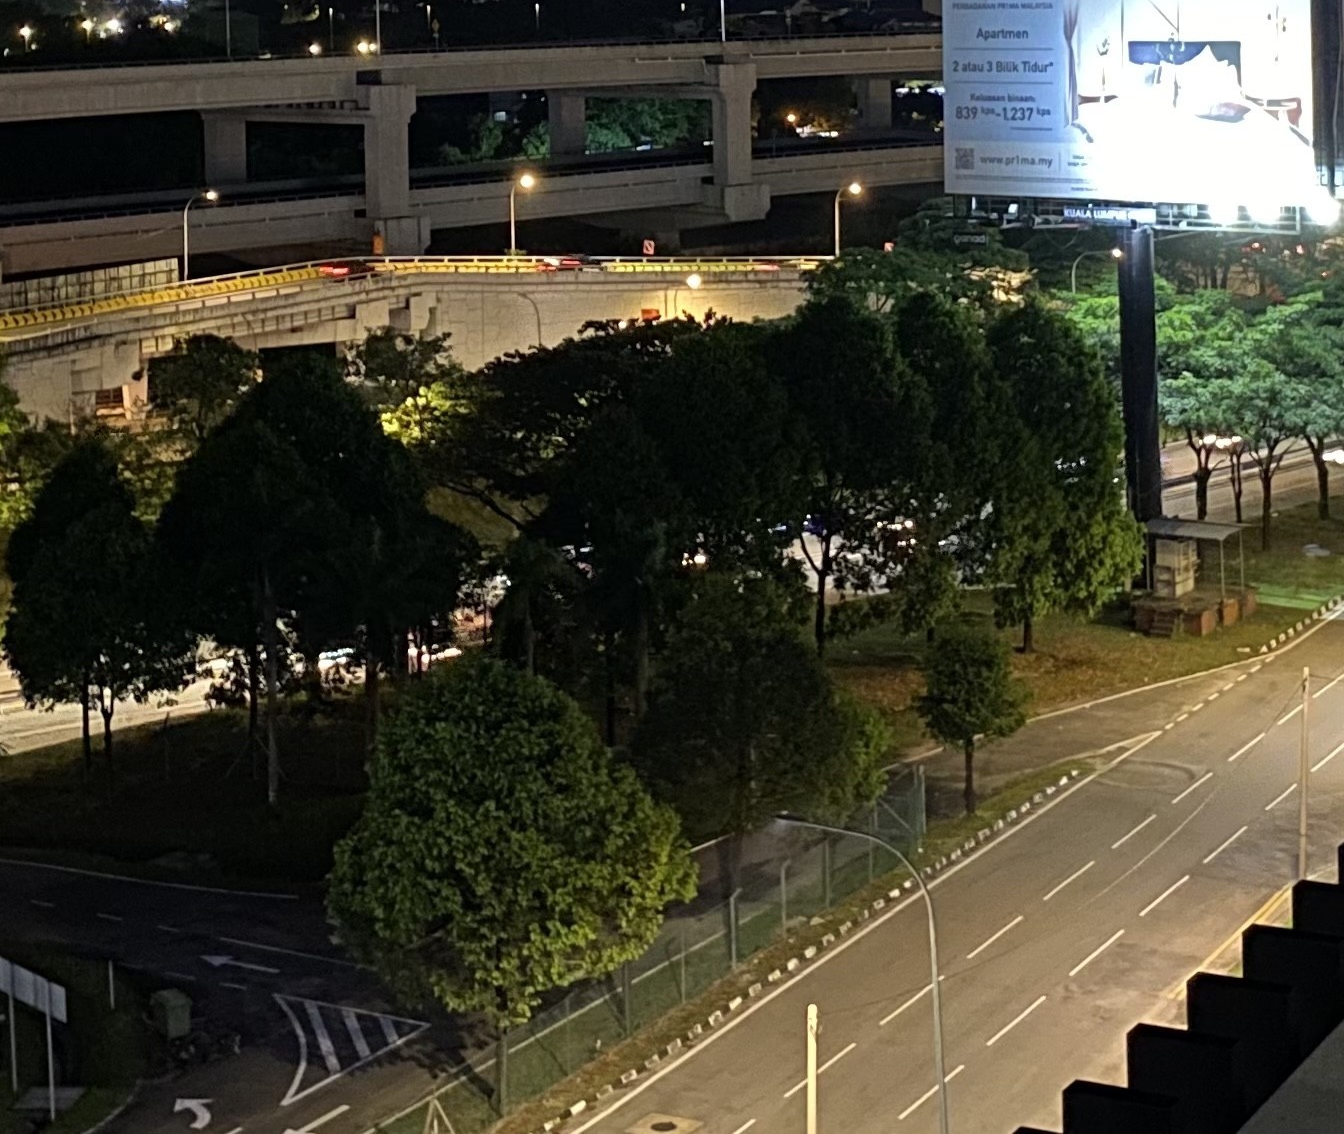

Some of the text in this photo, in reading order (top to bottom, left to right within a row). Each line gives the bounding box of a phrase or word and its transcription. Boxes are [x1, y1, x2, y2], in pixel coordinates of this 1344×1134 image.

[976, 28, 1029, 41] Apartmen
[953, 60, 960, 73] 2
[962, 61, 984, 73] atau
[986, 60, 993, 73] 3
[996, 60, 1019, 72] Bilik
[956, 106, 977, 119] 839
[1064, 208, 1092, 219] KUALA
